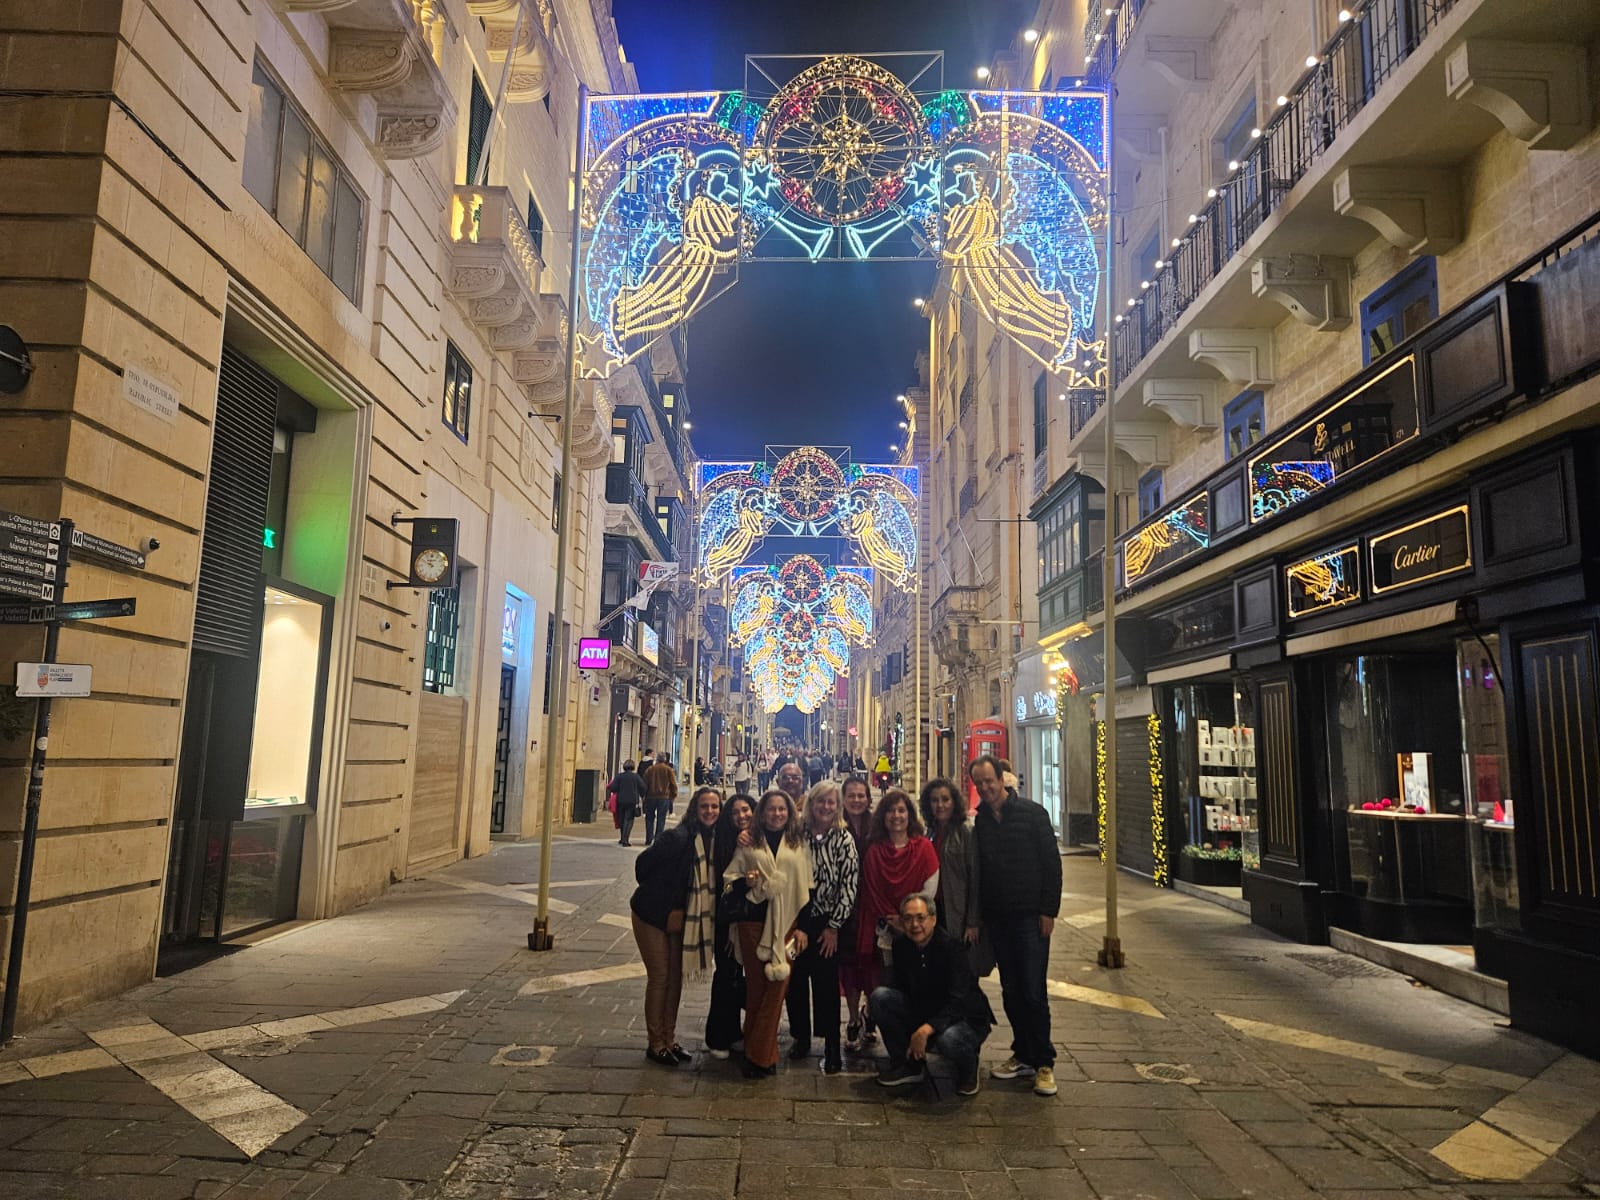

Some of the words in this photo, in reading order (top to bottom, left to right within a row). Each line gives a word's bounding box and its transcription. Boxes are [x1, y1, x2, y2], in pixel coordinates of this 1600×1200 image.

[32, 526, 49, 537] Station
[73, 531, 83, 545] M
[1394, 544, 1441, 570] Cartier
[43, 585, 53, 599] M
[581, 647, 609, 660] ATM
